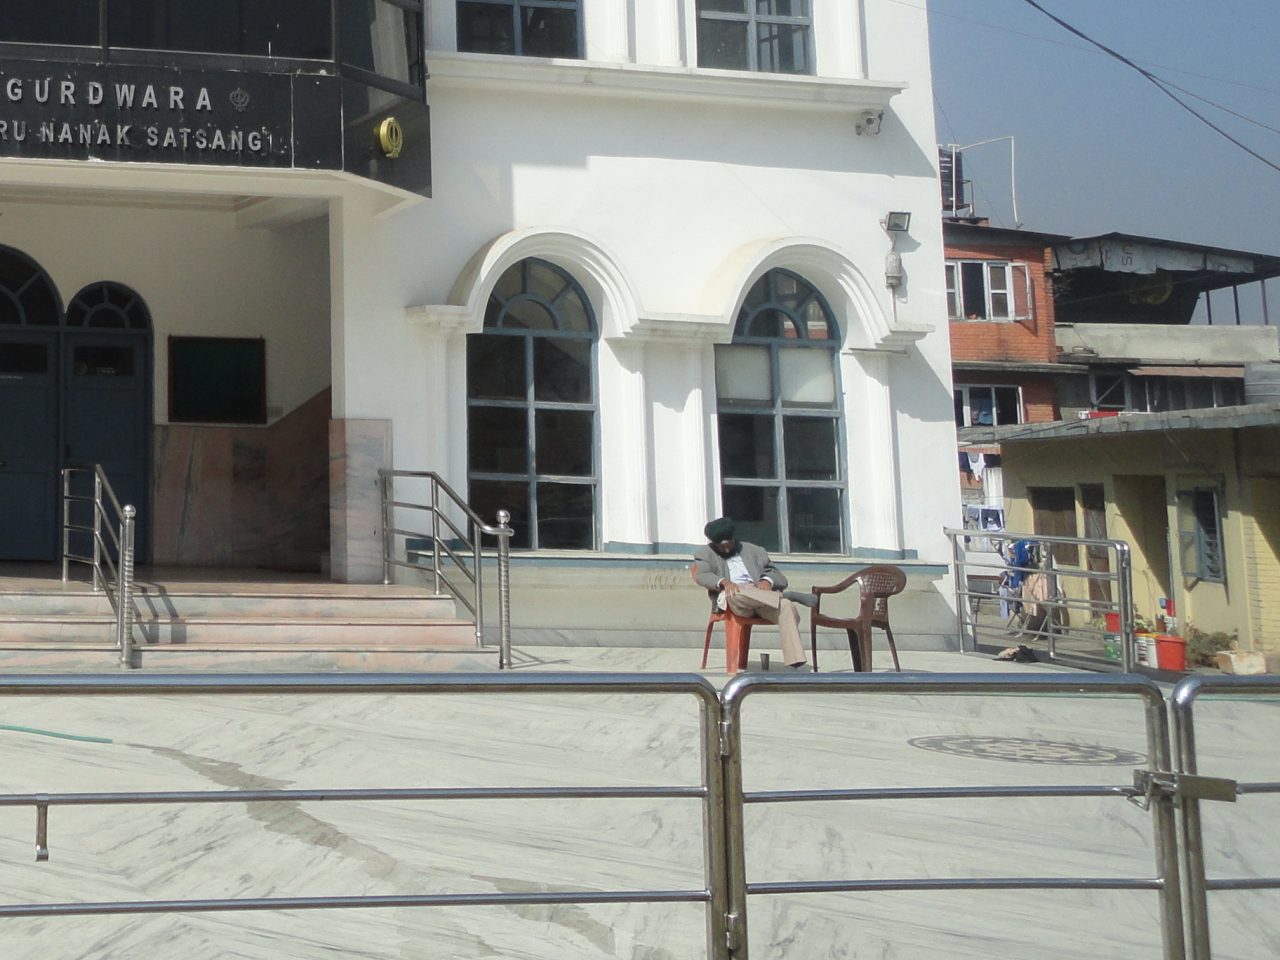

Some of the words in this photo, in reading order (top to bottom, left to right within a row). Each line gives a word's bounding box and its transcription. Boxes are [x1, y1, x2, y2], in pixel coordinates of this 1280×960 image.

[6, 78, 212, 111] GURDWARA
[41, 121, 132, 145] NANAK
[146, 126, 262, 151] SATSANG
